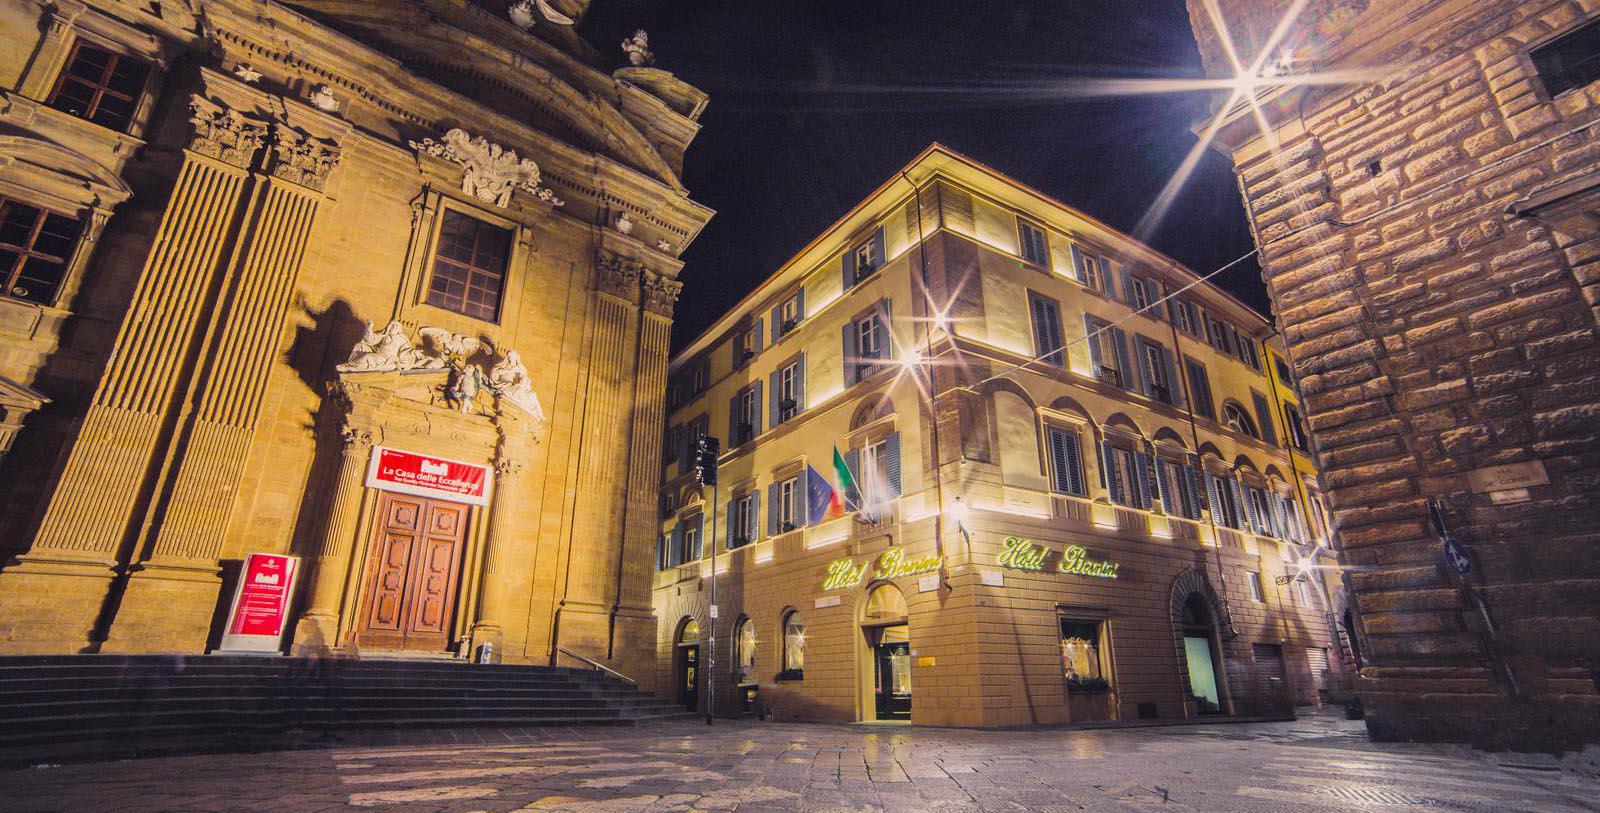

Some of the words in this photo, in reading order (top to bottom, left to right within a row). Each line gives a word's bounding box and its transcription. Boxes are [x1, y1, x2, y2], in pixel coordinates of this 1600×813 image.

[383, 466, 394, 475] La
[395, 468, 416, 479] Casa
[416, 472, 437, 483] delle
[1496, 467, 1512, 475] VIA
[823, 557, 869, 591] Hotel
[875, 544, 943, 580] Bernini
[998, 536, 1051, 571] Hotel
[1058, 544, 1120, 579] Bernini
